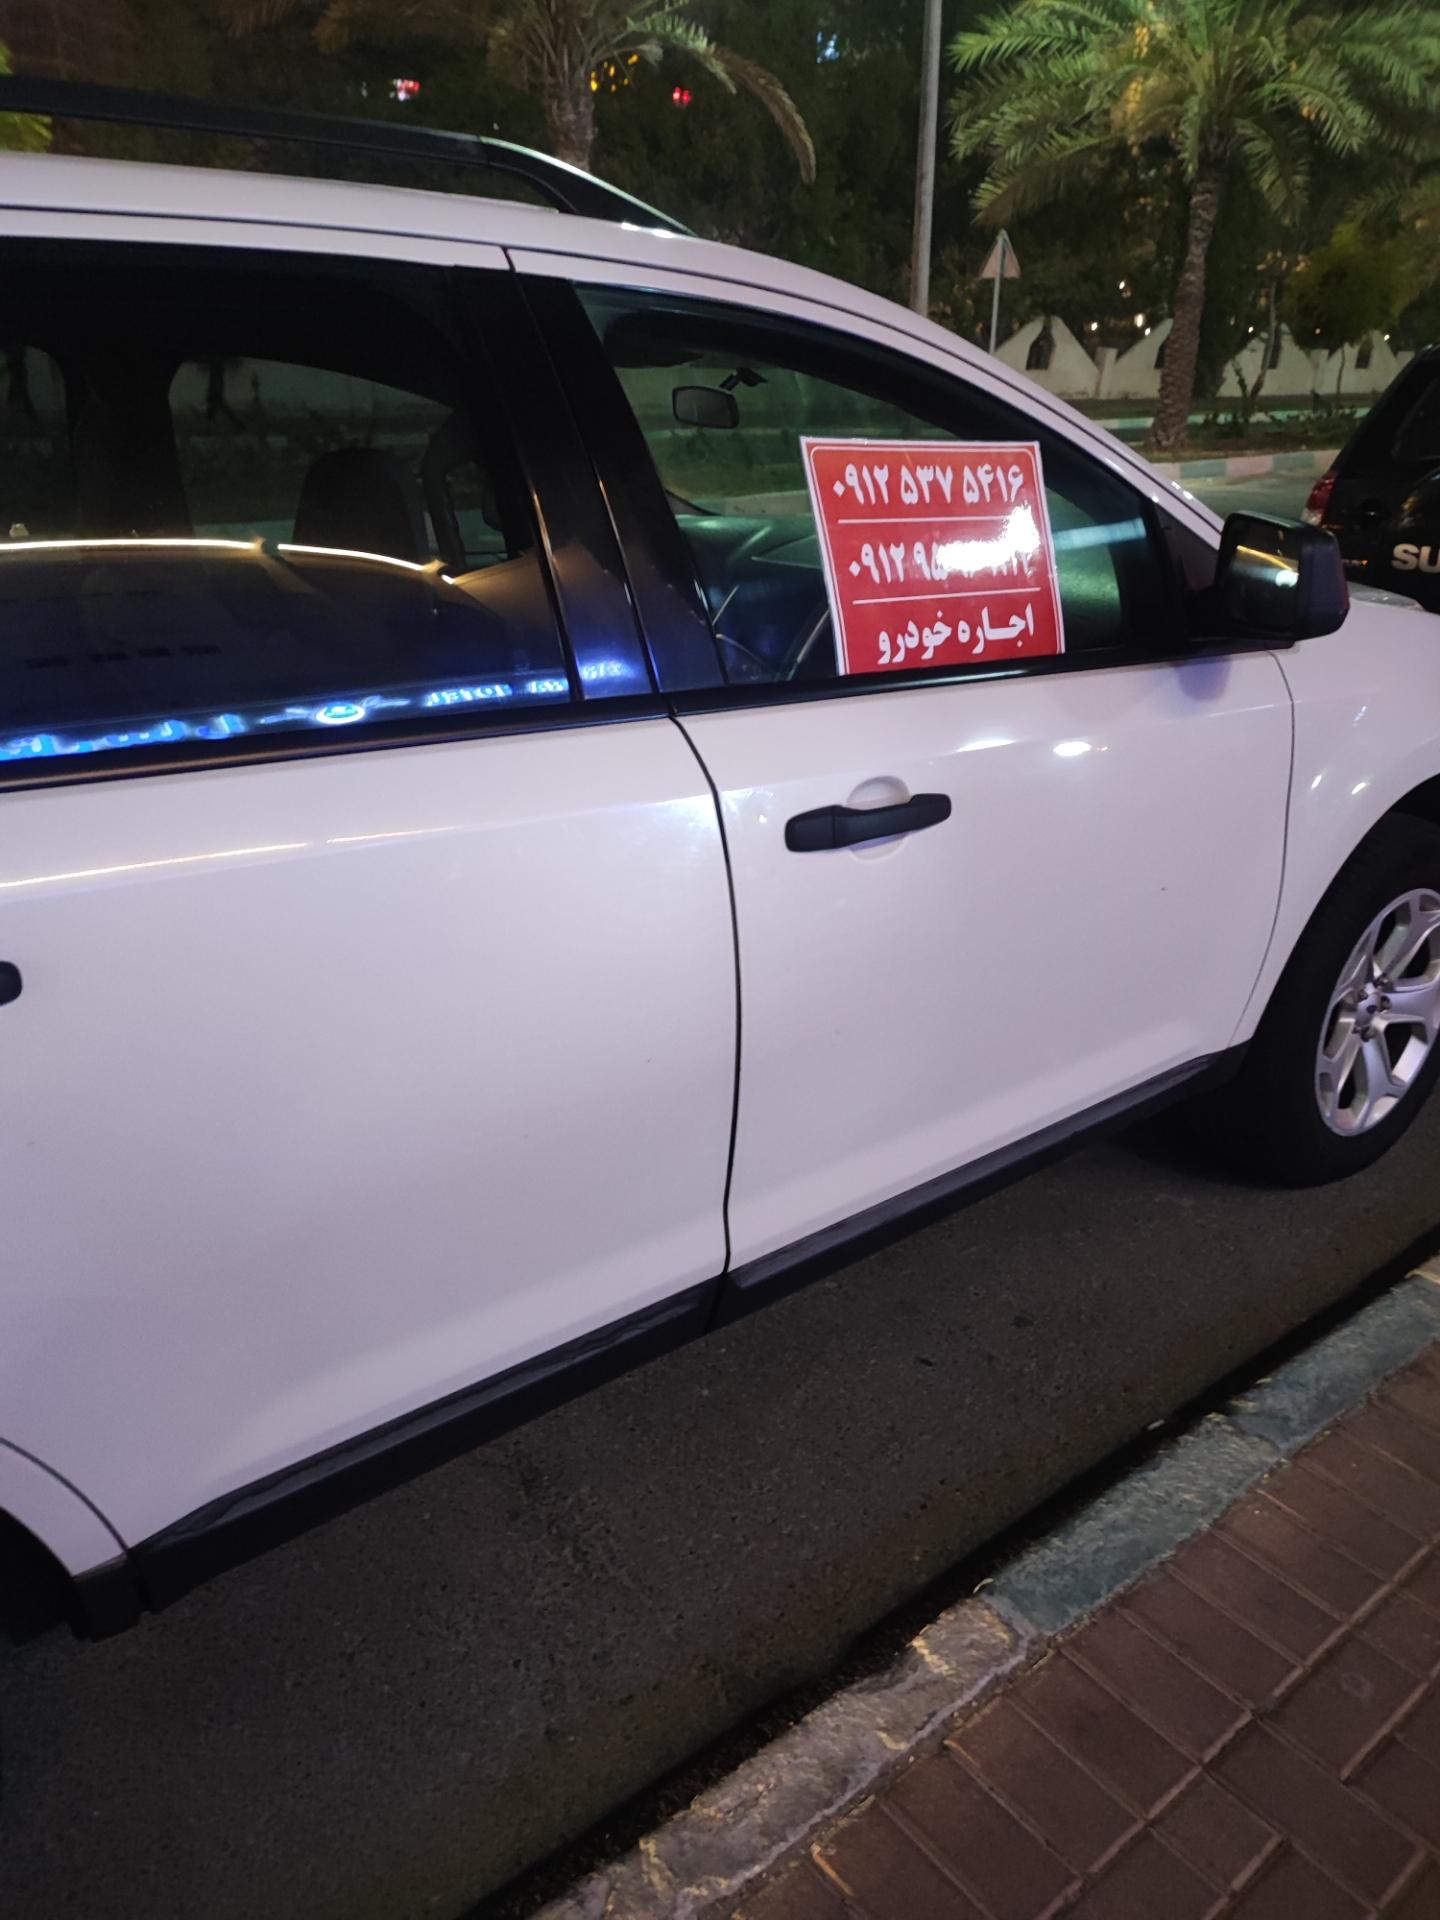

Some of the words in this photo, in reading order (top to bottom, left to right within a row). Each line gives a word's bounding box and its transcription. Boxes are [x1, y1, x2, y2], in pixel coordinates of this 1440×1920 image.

[832, 463, 889, 505] ۰۹۱۲
[900, 464, 953, 505] ۵۳۷
[962, 463, 1024, 505] ۵۴۱۶
[848, 542, 905, 584] ۰۹۱۲
[877, 610, 952, 665] خودرو
[957, 602, 1034, 655] اجاره
